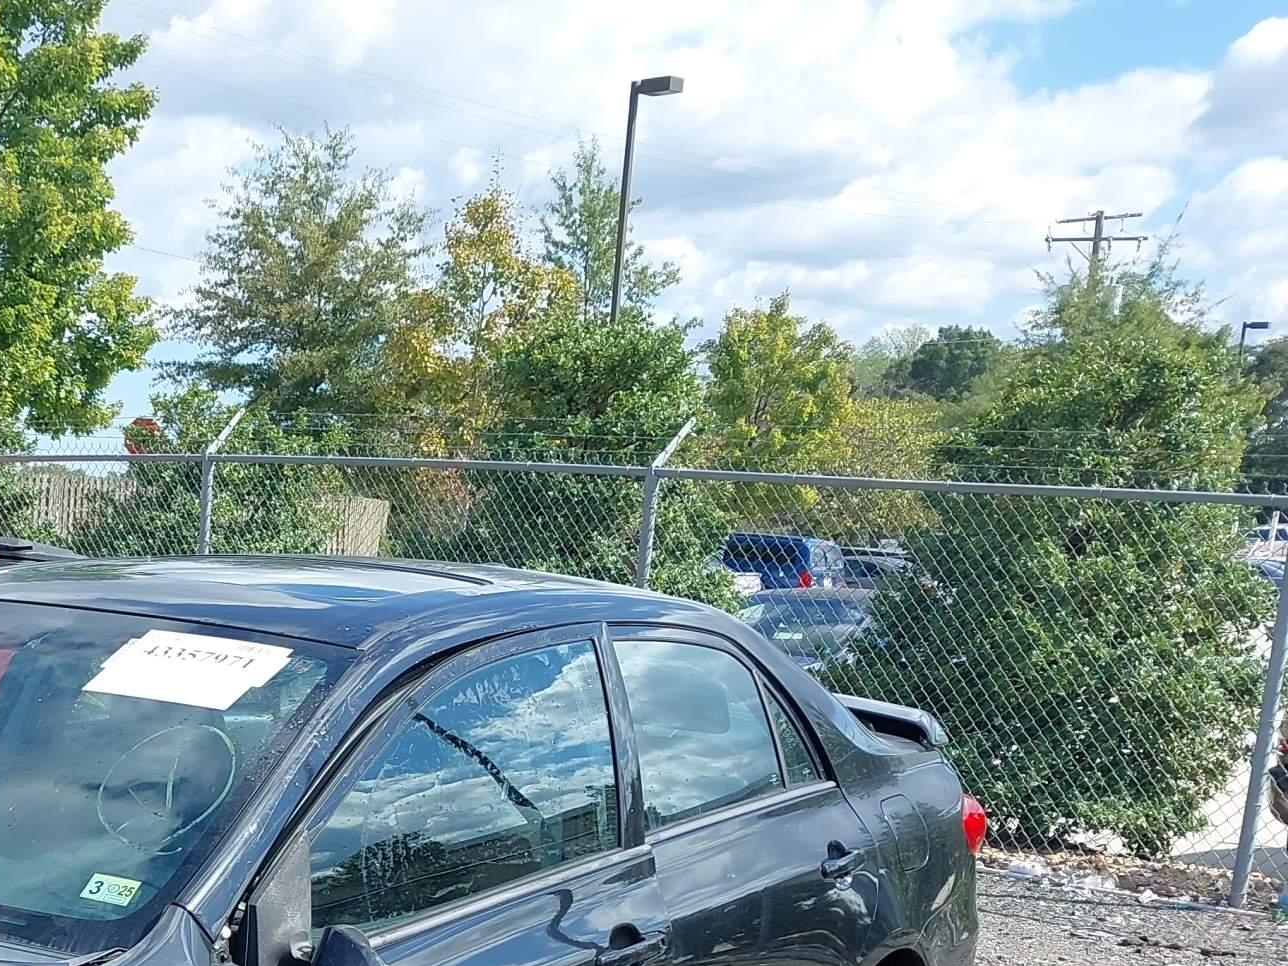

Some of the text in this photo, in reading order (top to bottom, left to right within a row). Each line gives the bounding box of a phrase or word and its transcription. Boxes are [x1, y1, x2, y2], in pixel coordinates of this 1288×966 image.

[144, 645, 256, 669] 43357971
[88, 880, 136, 898] 3 25
